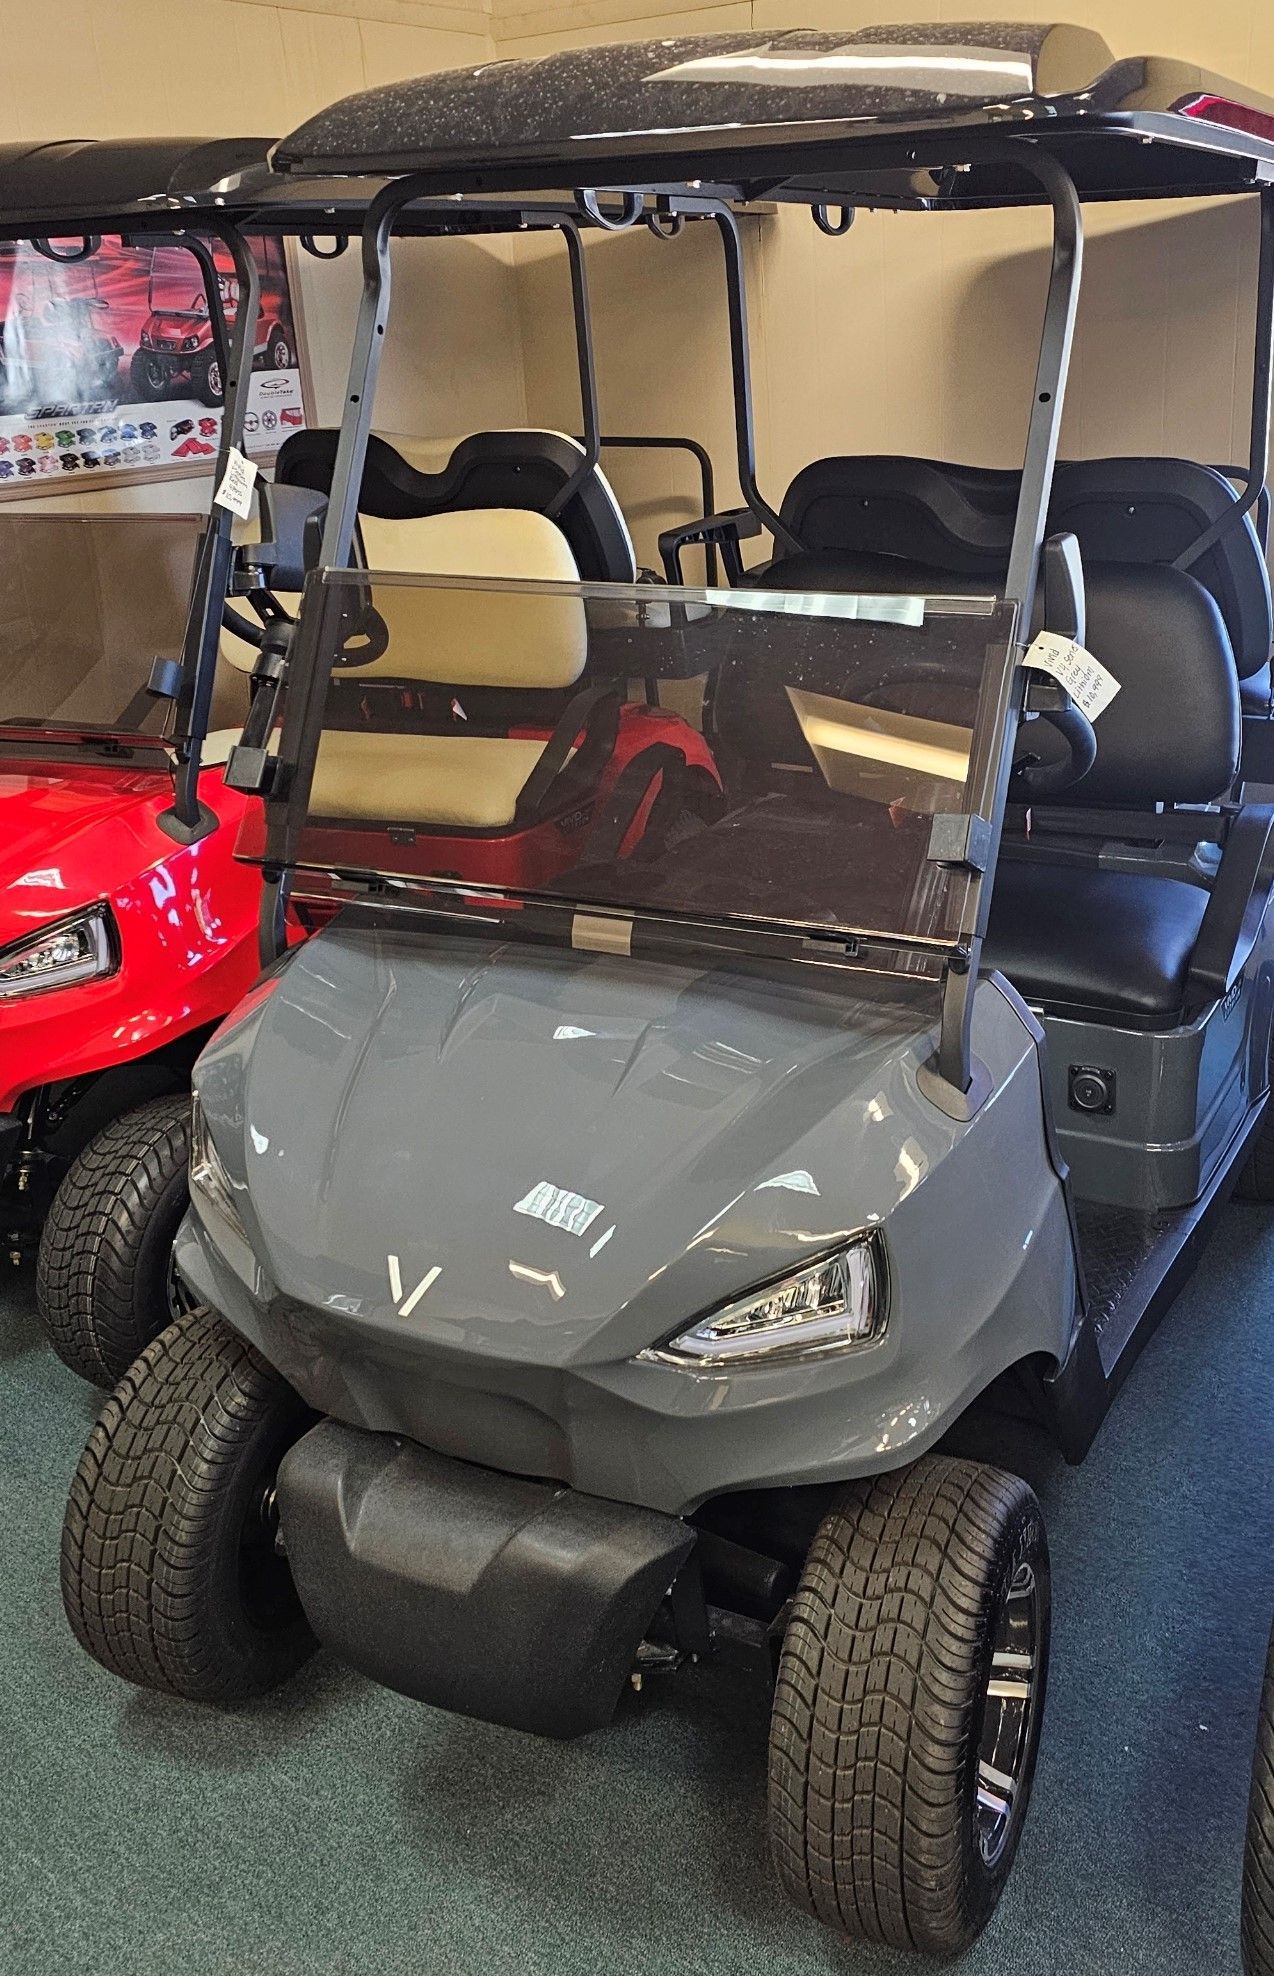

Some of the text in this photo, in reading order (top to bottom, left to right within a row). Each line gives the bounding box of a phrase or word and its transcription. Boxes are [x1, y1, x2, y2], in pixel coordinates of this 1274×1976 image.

[24, 398, 119, 420] SPARTAN
[1044, 648, 1060, 667] Vivid
[1055, 662, 1070, 676] V4
[1065, 665, 1085, 686] Grey
[1082, 673, 1104, 709] $10,999
